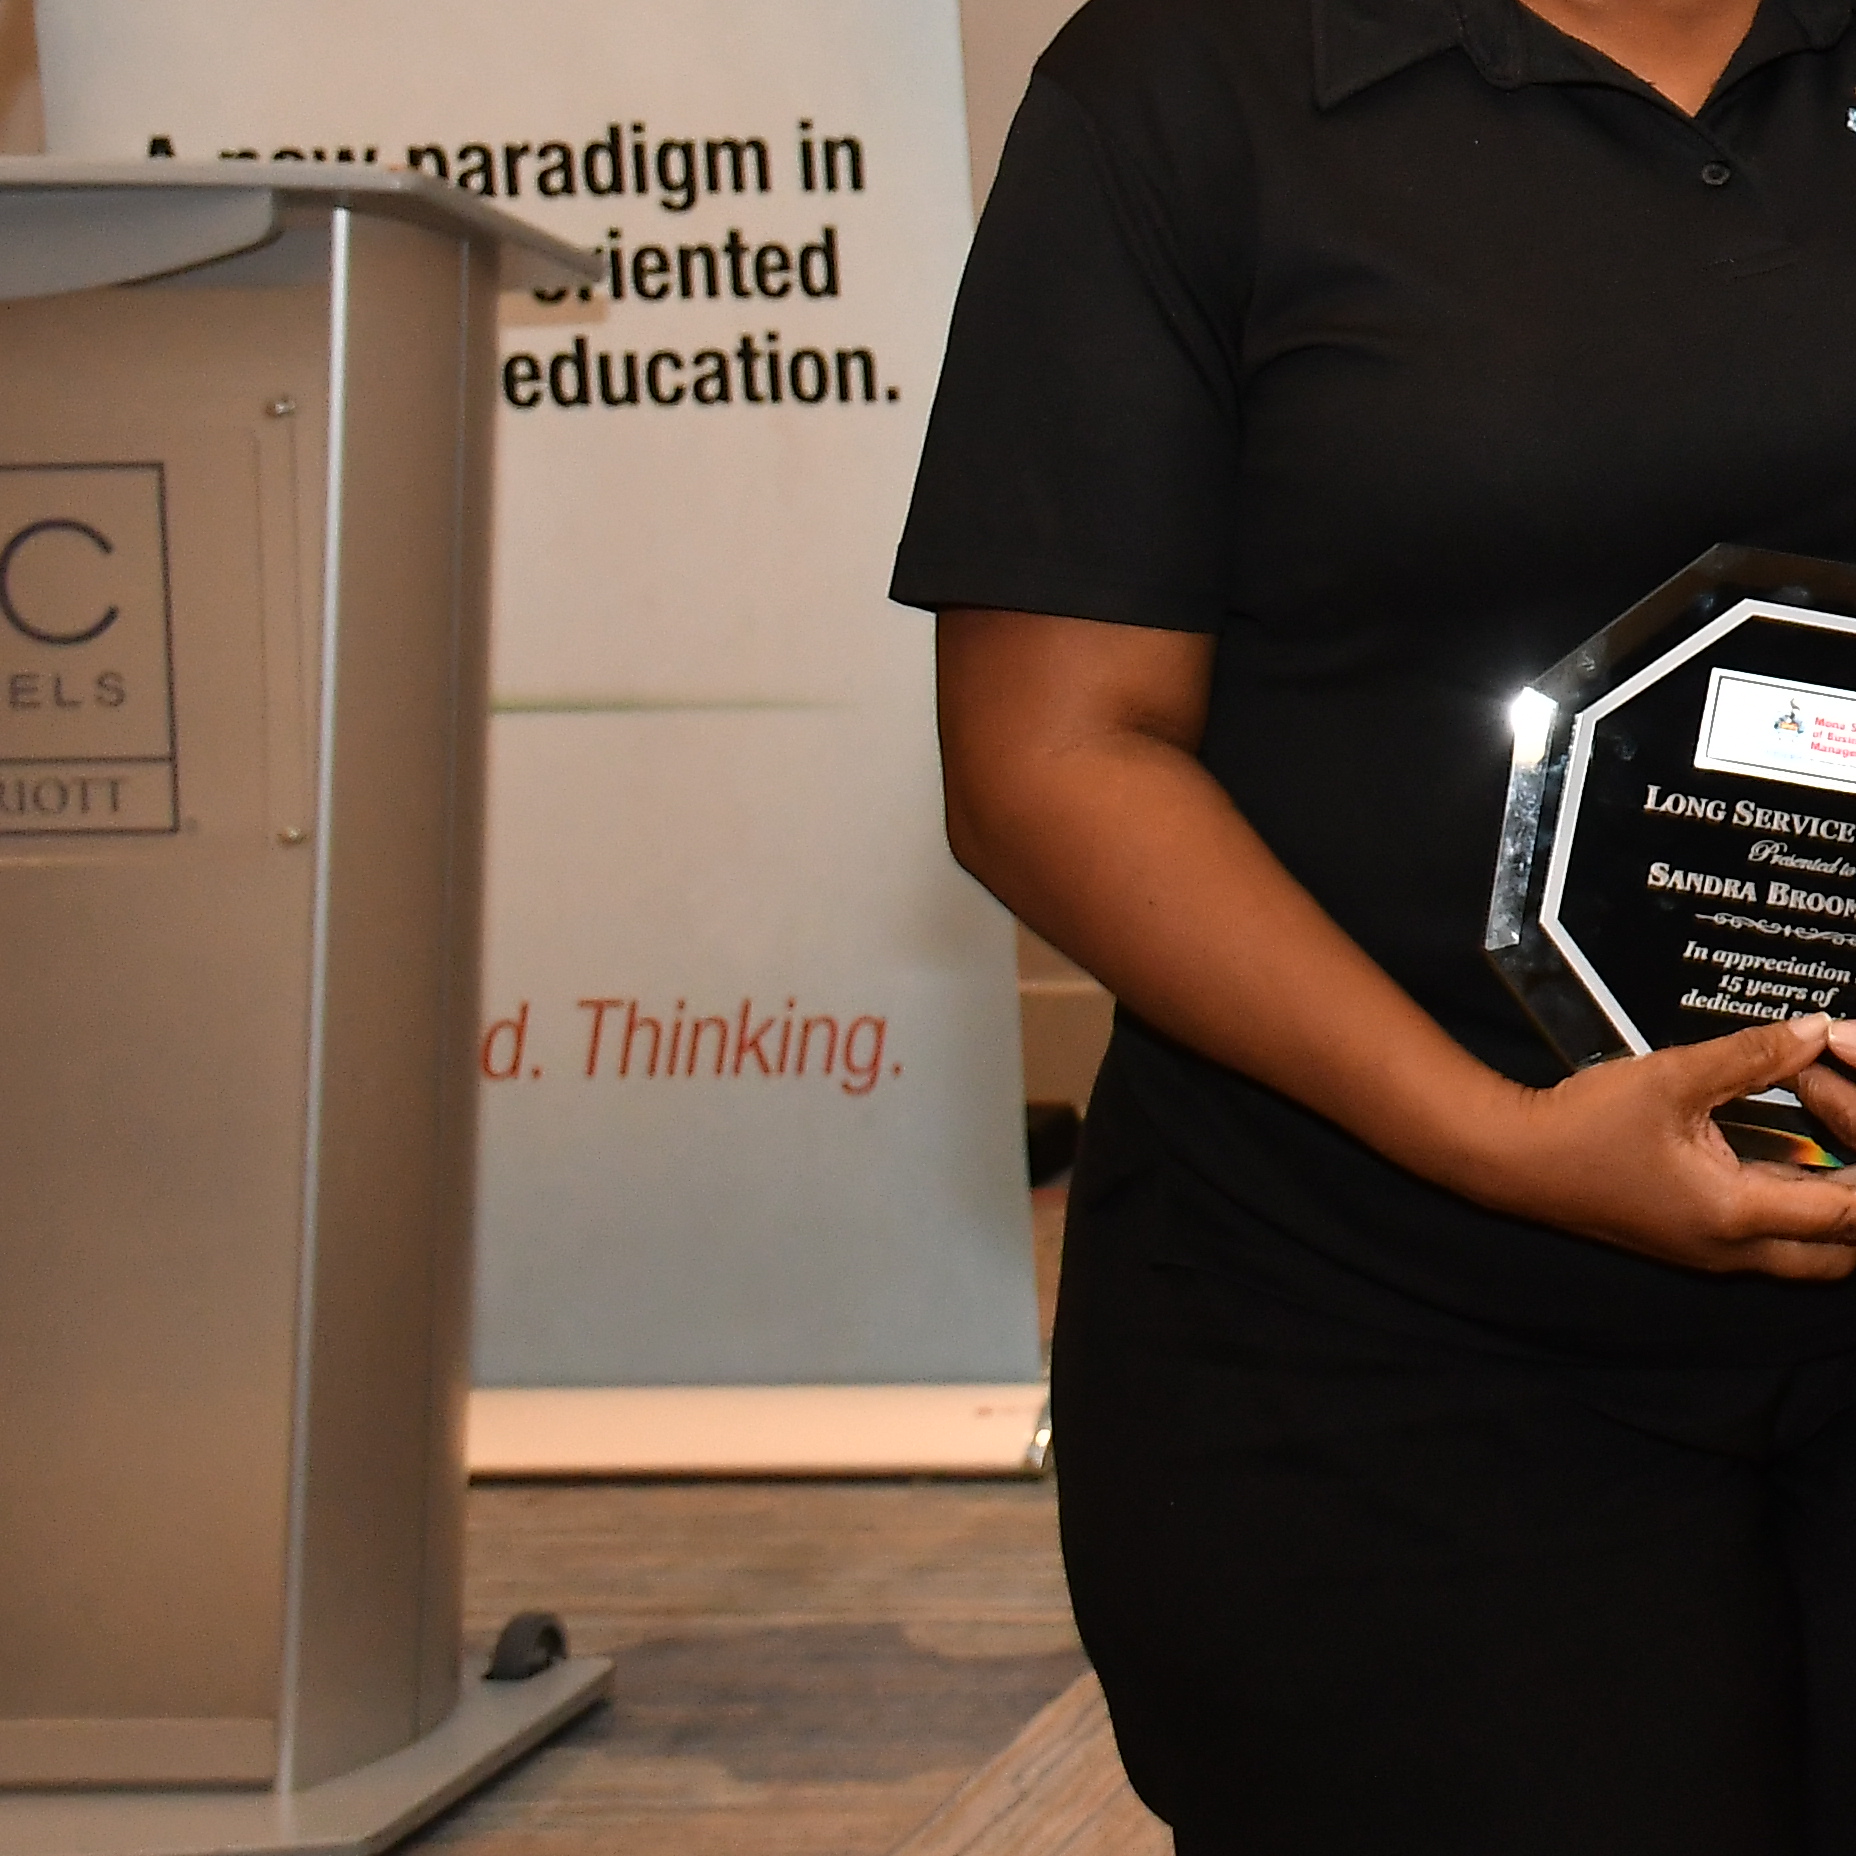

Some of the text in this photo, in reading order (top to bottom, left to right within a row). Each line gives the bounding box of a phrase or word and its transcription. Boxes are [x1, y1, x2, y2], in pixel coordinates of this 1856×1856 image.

[799, 118, 865, 193] in
[502, 333, 901, 410] education.
[9, 671, 127, 709] ELS
[1748, 839, 1841, 877] Presented
[1682, 940, 1709, 961] In
[1711, 948, 1851, 985] appreciation
[1680, 988, 1789, 1021] dedicated
[1718, 974, 1840, 1008] 15 years of
[577, 995, 903, 1097] Thinking.
